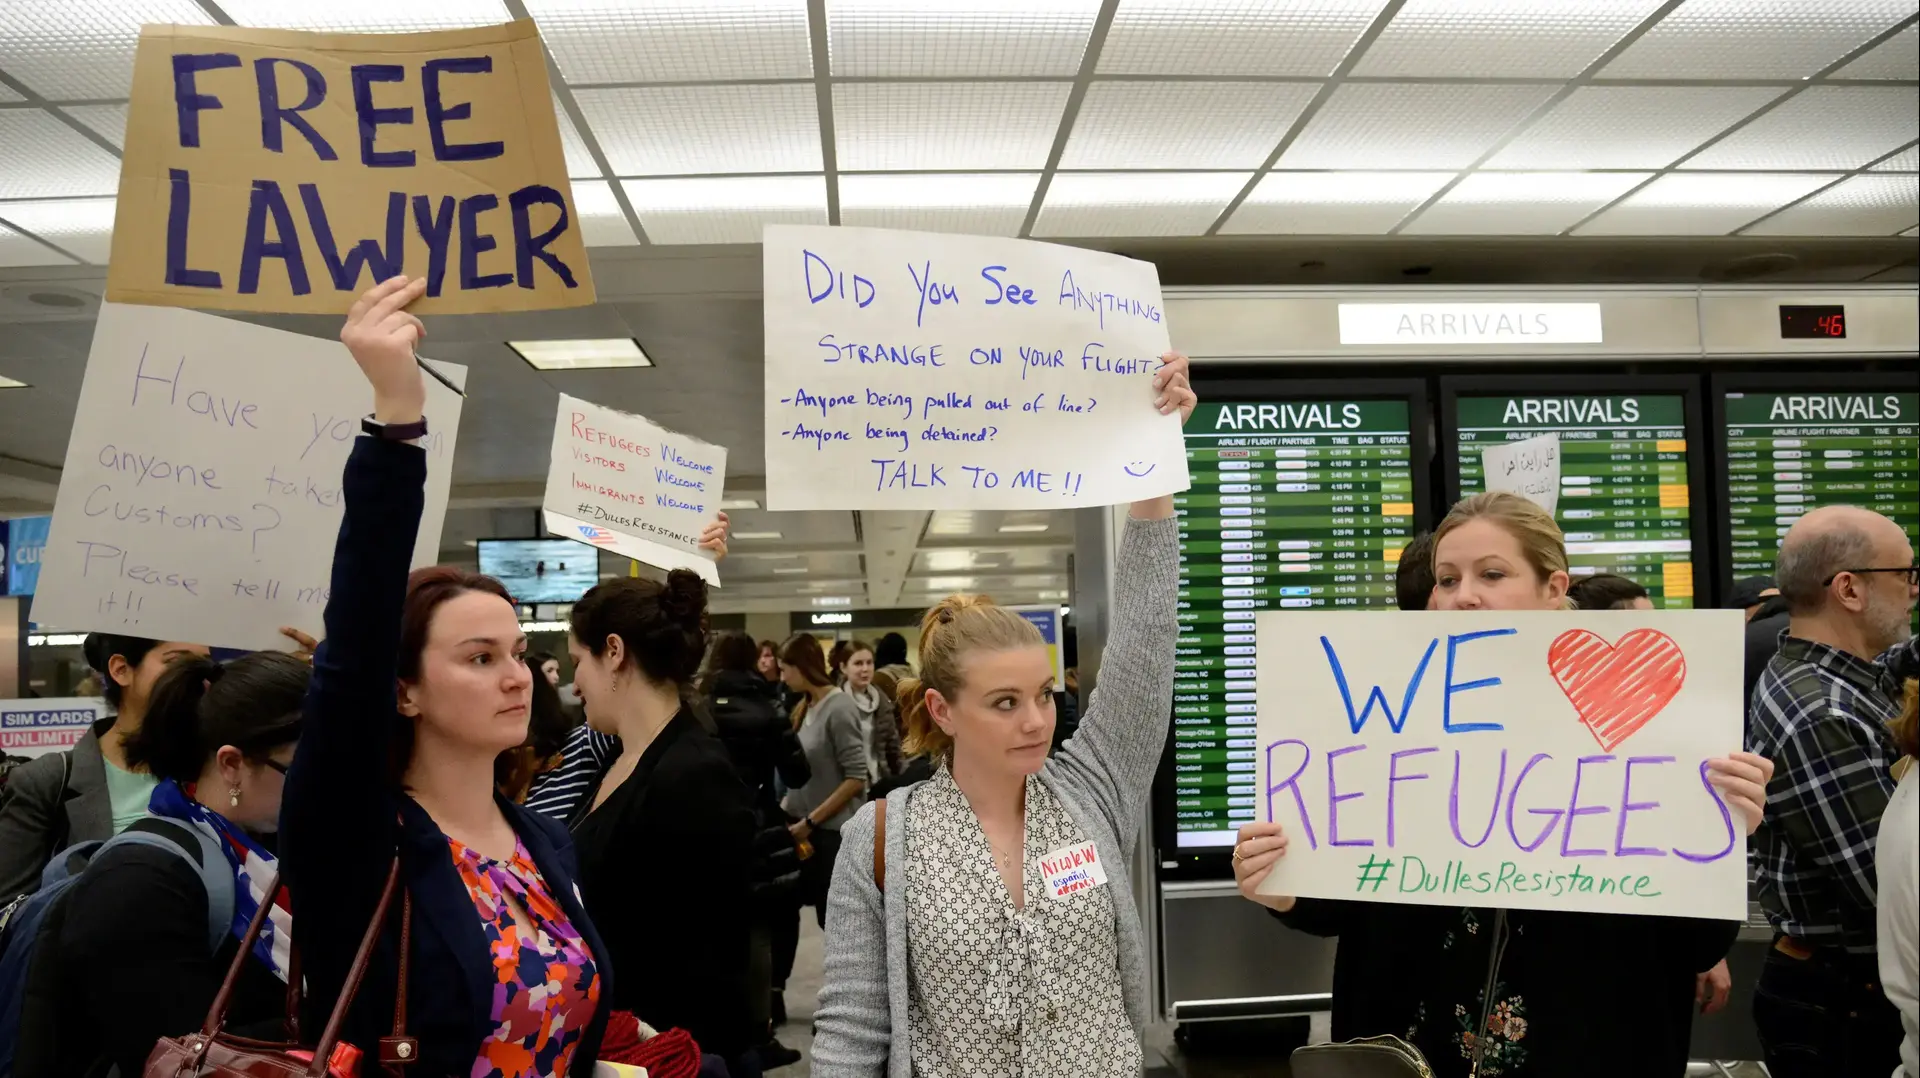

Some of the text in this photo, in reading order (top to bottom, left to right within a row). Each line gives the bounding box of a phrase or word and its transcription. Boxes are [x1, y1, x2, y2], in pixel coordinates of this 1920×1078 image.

[172, 53, 504, 168] FREE
[165, 168, 578, 297] LAWYER
[803, 249, 875, 308] DID
[1060, 269, 1161, 330] ANYTHING
[1396, 313, 1550, 337] ARRIVALS
[818, 334, 945, 367] STRANGE
[970, 347, 1002, 366] ON
[1019, 345, 1065, 380] YOUR
[132, 342, 259, 430] Have
[867, 390, 913, 420] being
[924, 394, 972, 420] pulled
[984, 399, 1011, 412] out
[1022, 393, 1046, 413] of
[1058, 393, 1097, 414] line?
[1215, 403, 1361, 430] ARRIVALS
[1503, 397, 1640, 424] ARRIVALS
[1769, 395, 1901, 420] ARRIVALS
[571, 412, 714, 475] REFUGEES WELCOME
[866, 425, 909, 452] being
[921, 424, 999, 442] detained?
[1218, 438, 1246, 446] AIRLINE
[1251, 438, 1277, 446] FLIGHT
[1282, 437, 1316, 446] PARTNER
[1380, 436, 1407, 444] STATUS
[1565, 431, 1598, 439] PARTNER
[1636, 430, 1651, 438] BAG
[1657, 430, 1683, 438] STATUS
[1802, 428, 1825, 436] FLIGHT
[98, 443, 222, 490] anyone
[572, 447, 705, 493] VISITORS WELCOME
[871, 460, 946, 492] TALK
[961, 466, 999, 490] TO
[572, 472, 704, 513] IMMIGRANTS WELCOME
[84, 485, 281, 563] Customs?
[77, 540, 200, 596] Please
[232, 579, 280, 601] tell
[1320, 628, 1518, 734] WE
[1, 730, 85, 746] UNLIMITE
[5, 711, 93, 726] SIM CARDS
[1266, 738, 1737, 863] REFUGEES
[1053, 869, 1090, 888] español
[1356, 853, 1661, 898] #DullesResistance
